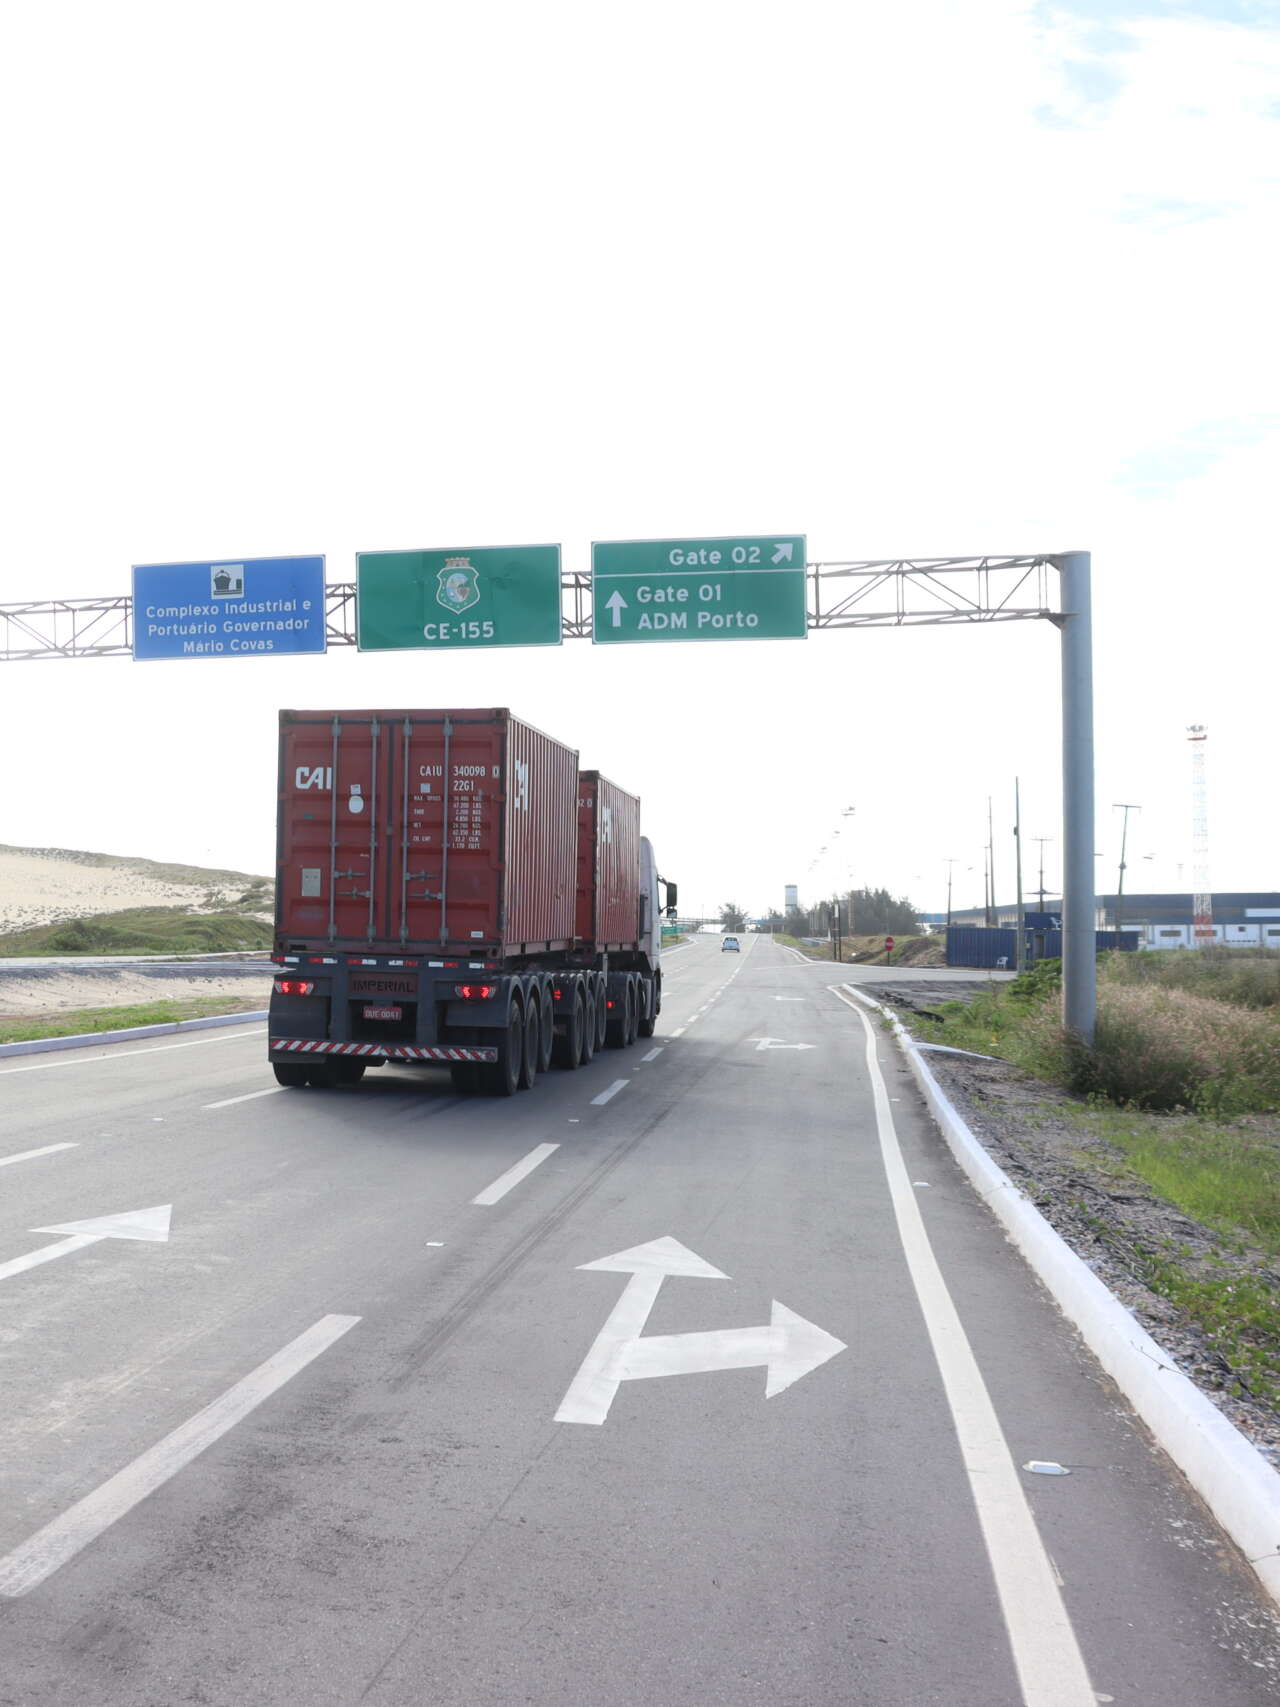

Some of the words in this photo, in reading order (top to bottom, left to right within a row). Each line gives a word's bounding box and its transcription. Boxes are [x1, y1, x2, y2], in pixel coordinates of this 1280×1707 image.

[669, 547, 721, 566] Gate
[731, 546, 761, 563] 02
[637, 586, 689, 603] Gate
[699, 584, 721, 601] 01
[146, 604, 219, 619] Complexo
[225, 599, 297, 614] Industrial
[302, 600, 312, 610] e
[148, 622, 217, 637] Portuário
[223, 618, 310, 633] Governador
[637, 612, 688, 630] ADM
[697, 610, 759, 628] Porto
[423, 621, 494, 640] CE-155
[184, 640, 224, 653] Mário
[230, 638, 274, 651] Covas
[296, 766, 332, 790] CAI
[419, 765, 442, 777] CAIU
[452, 765, 486, 777] 340098
[353, 980, 414, 993] IMPERIAL
